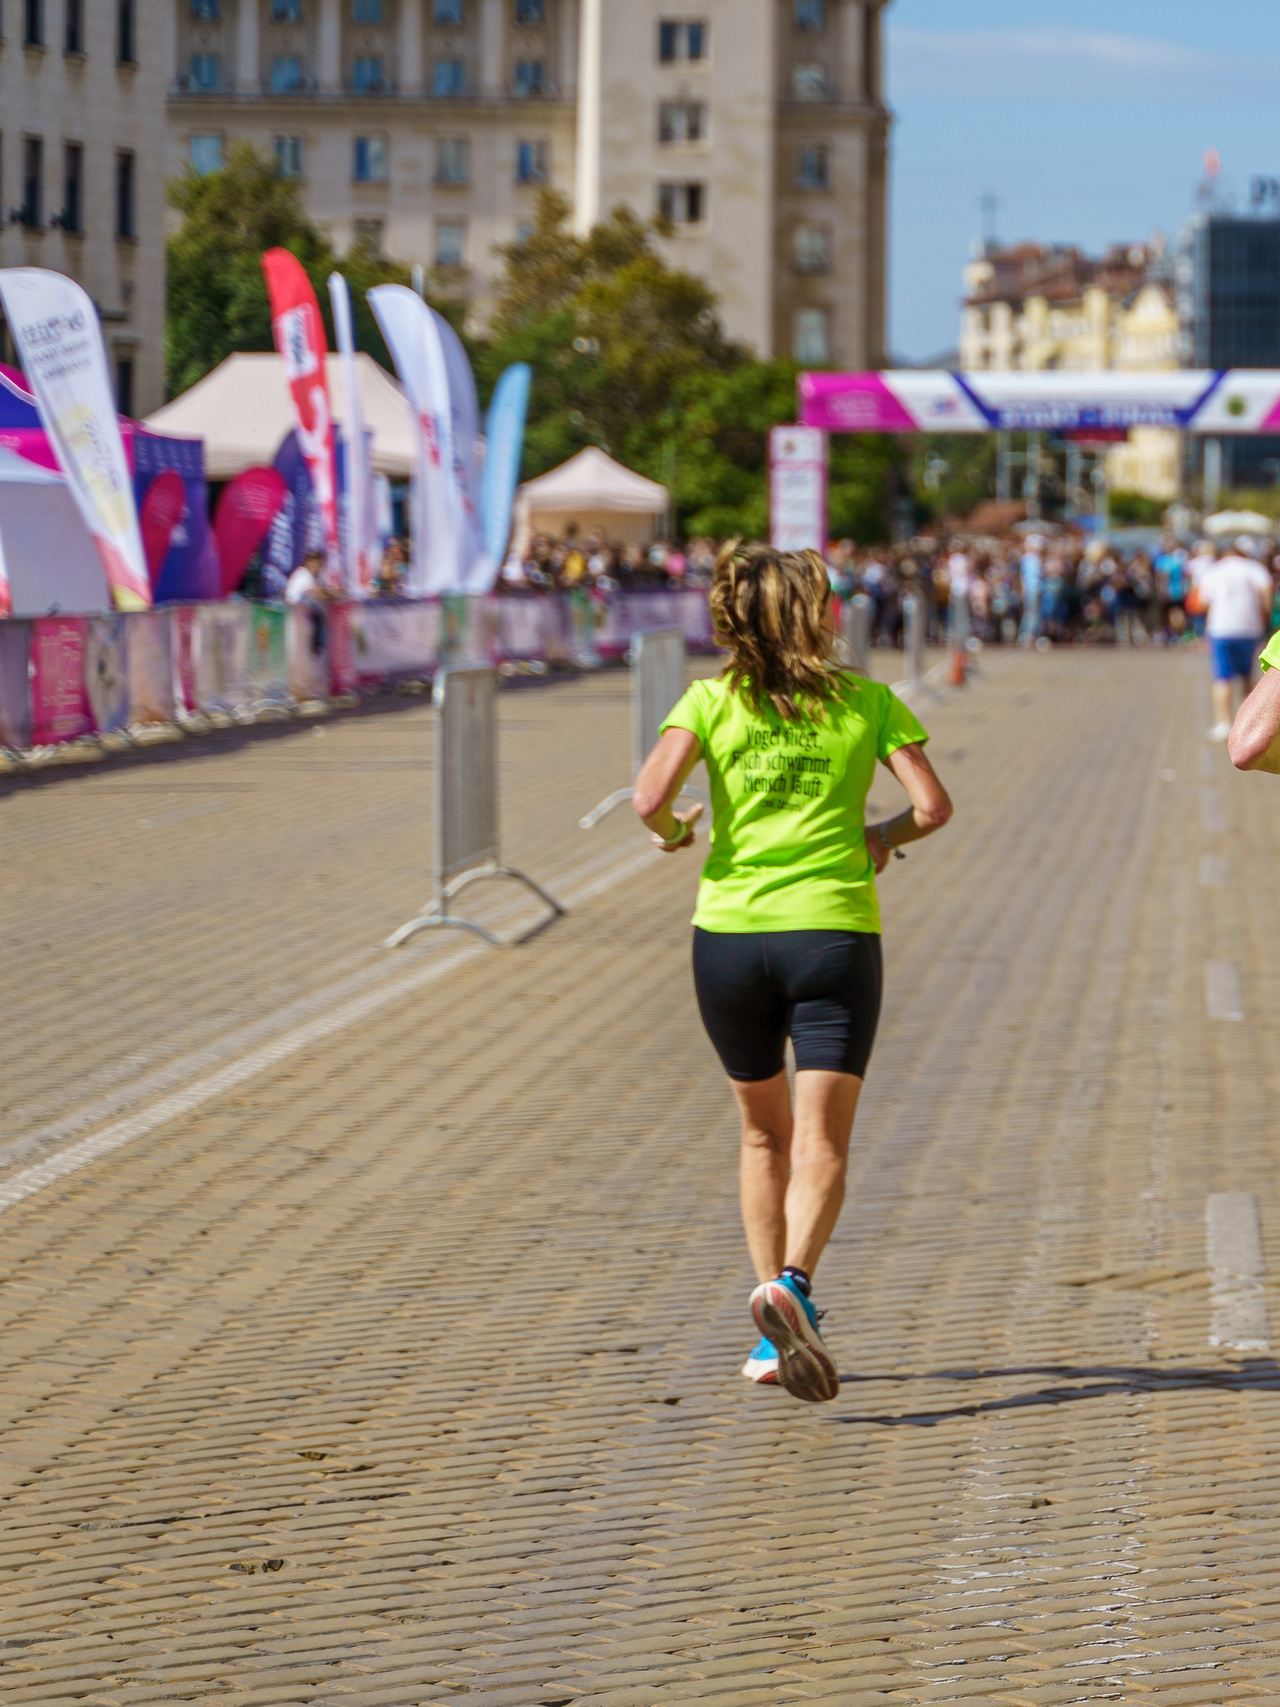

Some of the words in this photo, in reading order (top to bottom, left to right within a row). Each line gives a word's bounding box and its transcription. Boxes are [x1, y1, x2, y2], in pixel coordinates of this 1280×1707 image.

[746, 725, 781, 750] Vogel
[785, 727, 823, 751] fliegt,
[732, 751, 761, 770] Fisch
[767, 752, 835, 778] schwimmt,
[743, 774, 787, 794] Mensch
[791, 774, 826, 798] läuft.
